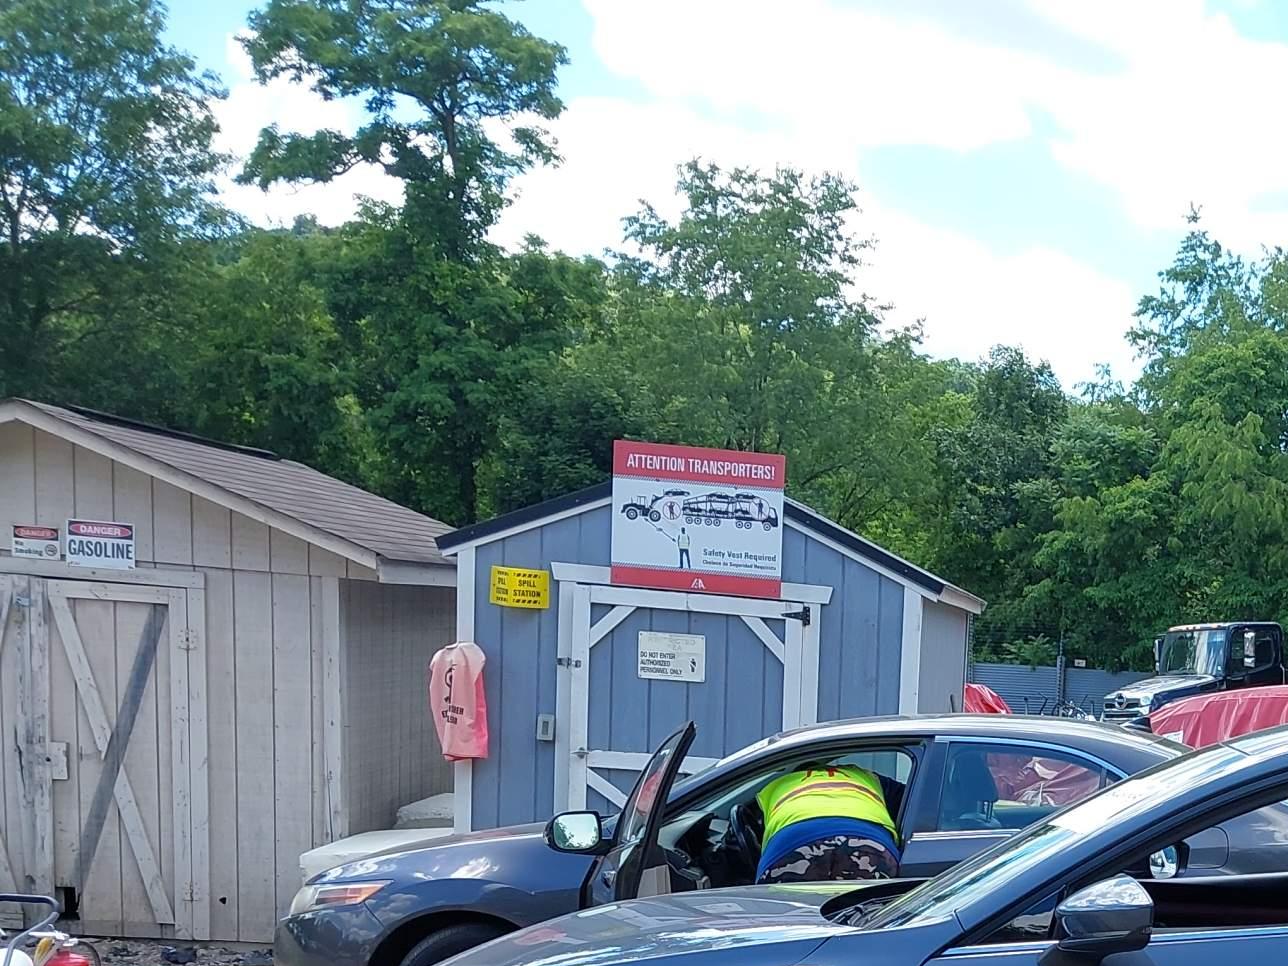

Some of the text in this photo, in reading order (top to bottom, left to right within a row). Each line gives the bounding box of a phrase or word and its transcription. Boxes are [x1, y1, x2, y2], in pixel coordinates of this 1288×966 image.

[627, 453, 775, 480] ATTENTION TRANSPORTERS!
[80, 522, 121, 536] DANGER
[68, 539, 133, 560] GASOLINE
[703, 548, 777, 562] Safety Vest Required
[518, 579, 537, 588] SPILL
[512, 589, 541, 598] STATION
[640, 650, 676, 660] DO NOT ENTER
